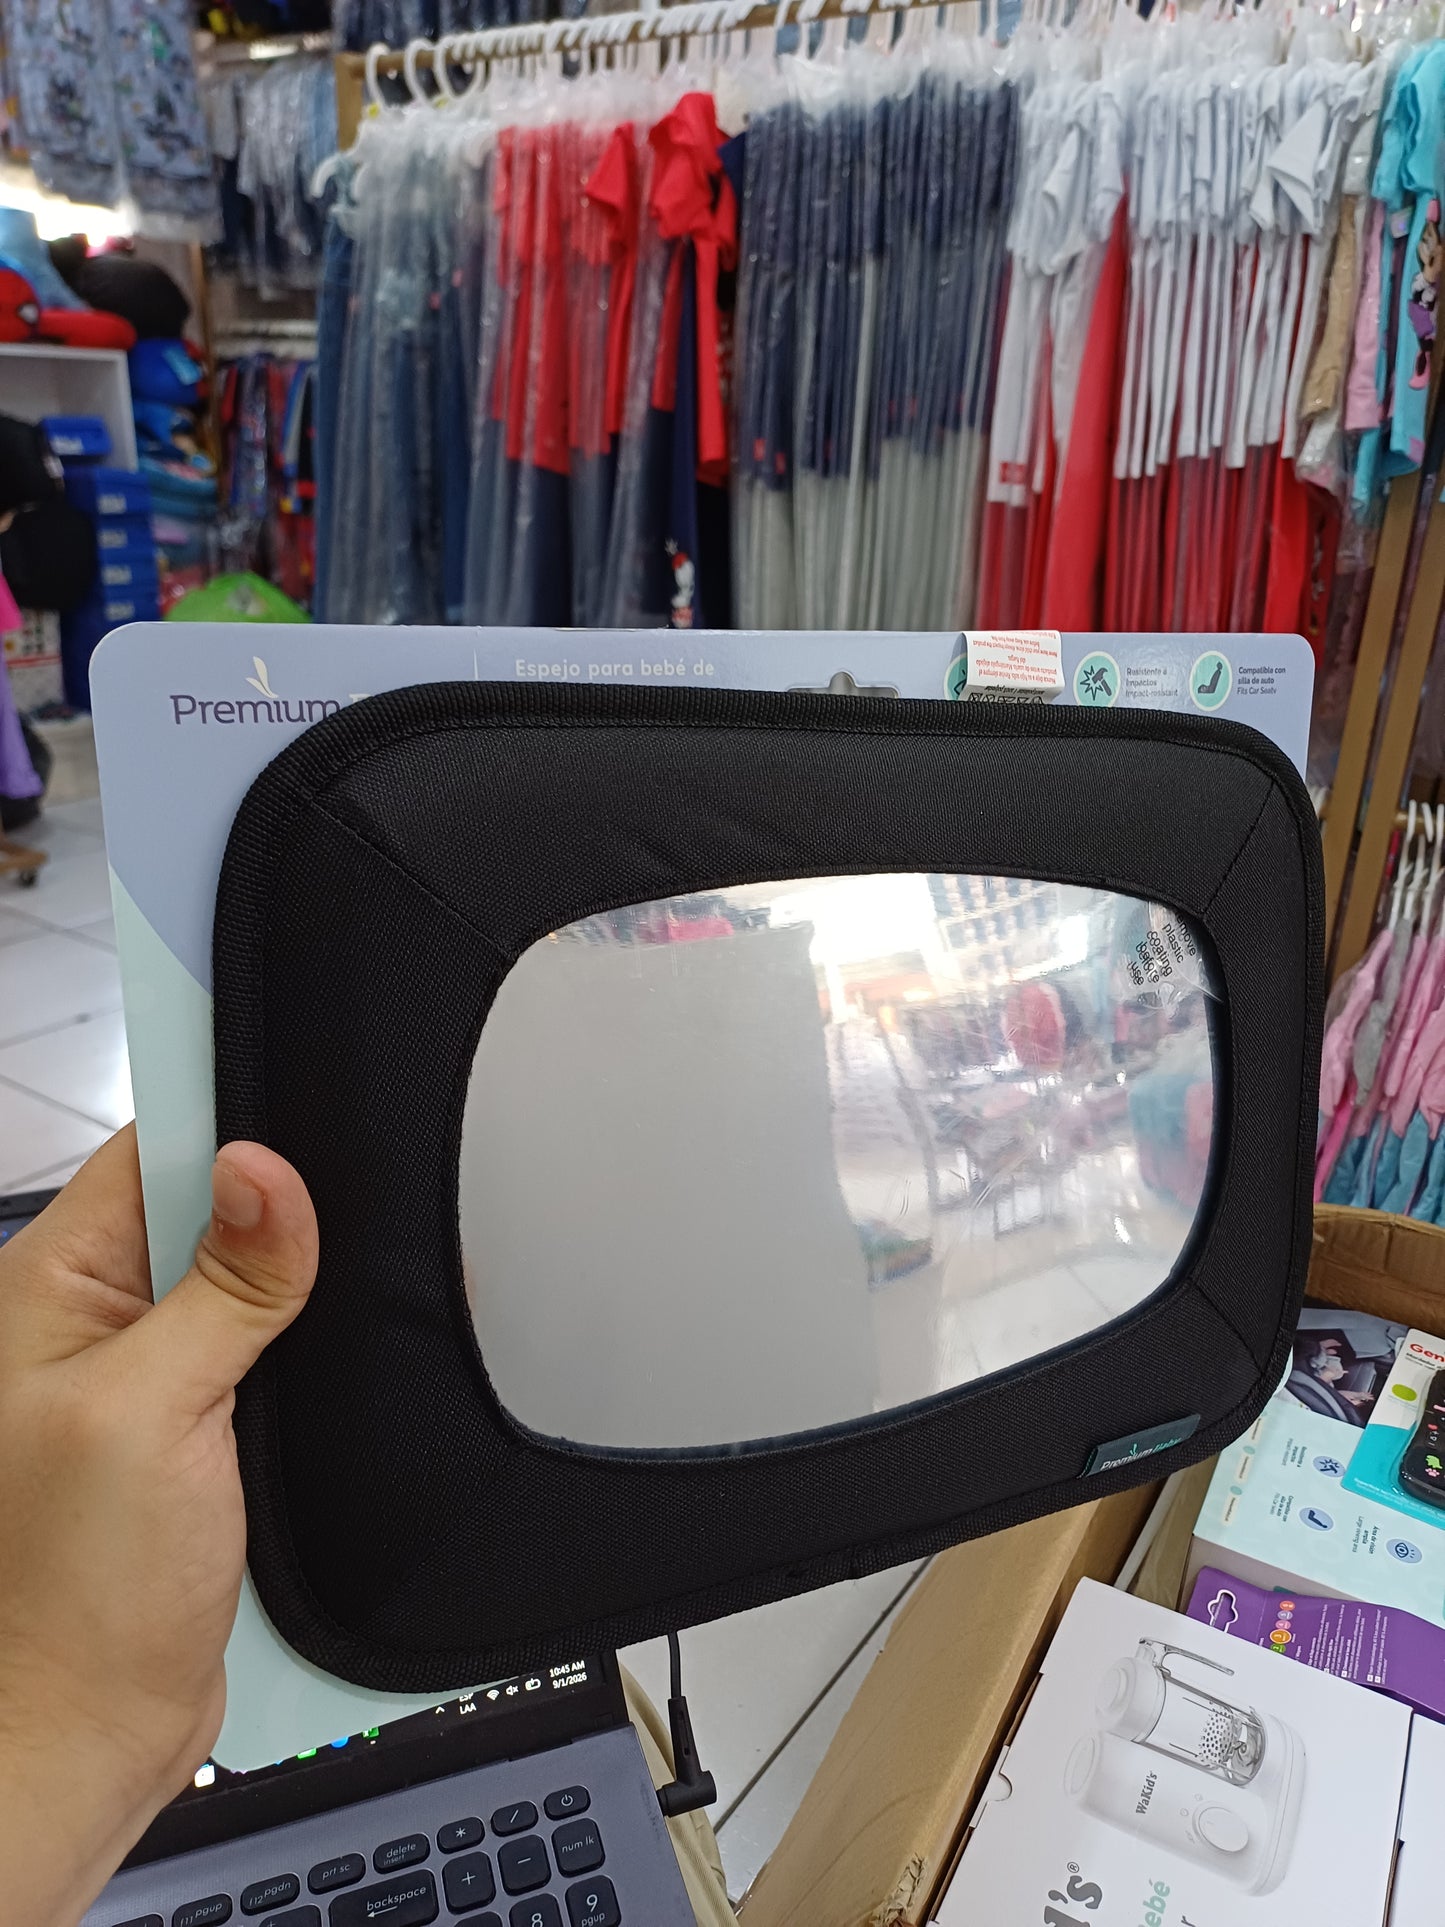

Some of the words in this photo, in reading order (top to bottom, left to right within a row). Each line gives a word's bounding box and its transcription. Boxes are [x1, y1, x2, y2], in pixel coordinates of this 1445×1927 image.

[515, 659, 580, 681] Espejo
[588, 663, 633, 680] para
[641, 658, 686, 676] bebé
[693, 659, 715, 676] de
[1239, 666, 1274, 675] Compatible
[169, 694, 341, 725] Premium
[1162, 923, 1184, 964] plastic
[1175, 912, 1197, 957] emove
[1149, 931, 1173, 977] coating
[549, 1664, 570, 1678] 10:45
[571, 1660, 586, 1672] AM
[552, 1672, 588, 1689] 9/1/2026
[459, 1703, 477, 1715] LAA
[1135, 1770, 1158, 1815] WaKid's
[386, 1842, 417, 1858] delete
[562, 1840, 583, 1854] num
[585, 1835, 595, 1846] lk
[383, 1854, 405, 1866] insert
[322, 1866, 337, 1880] prt
[340, 1863, 351, 1873] sc
[264, 1881, 292, 1898] pgdn
[366, 1886, 427, 1911] backspace
[194, 1902, 223, 1919] pgup
[586, 1894, 598, 1913] 9
[1138, 1878, 1171, 1927] ebé
[531, 1912, 543, 1927] 8
[581, 1912, 606, 1927] pgup
